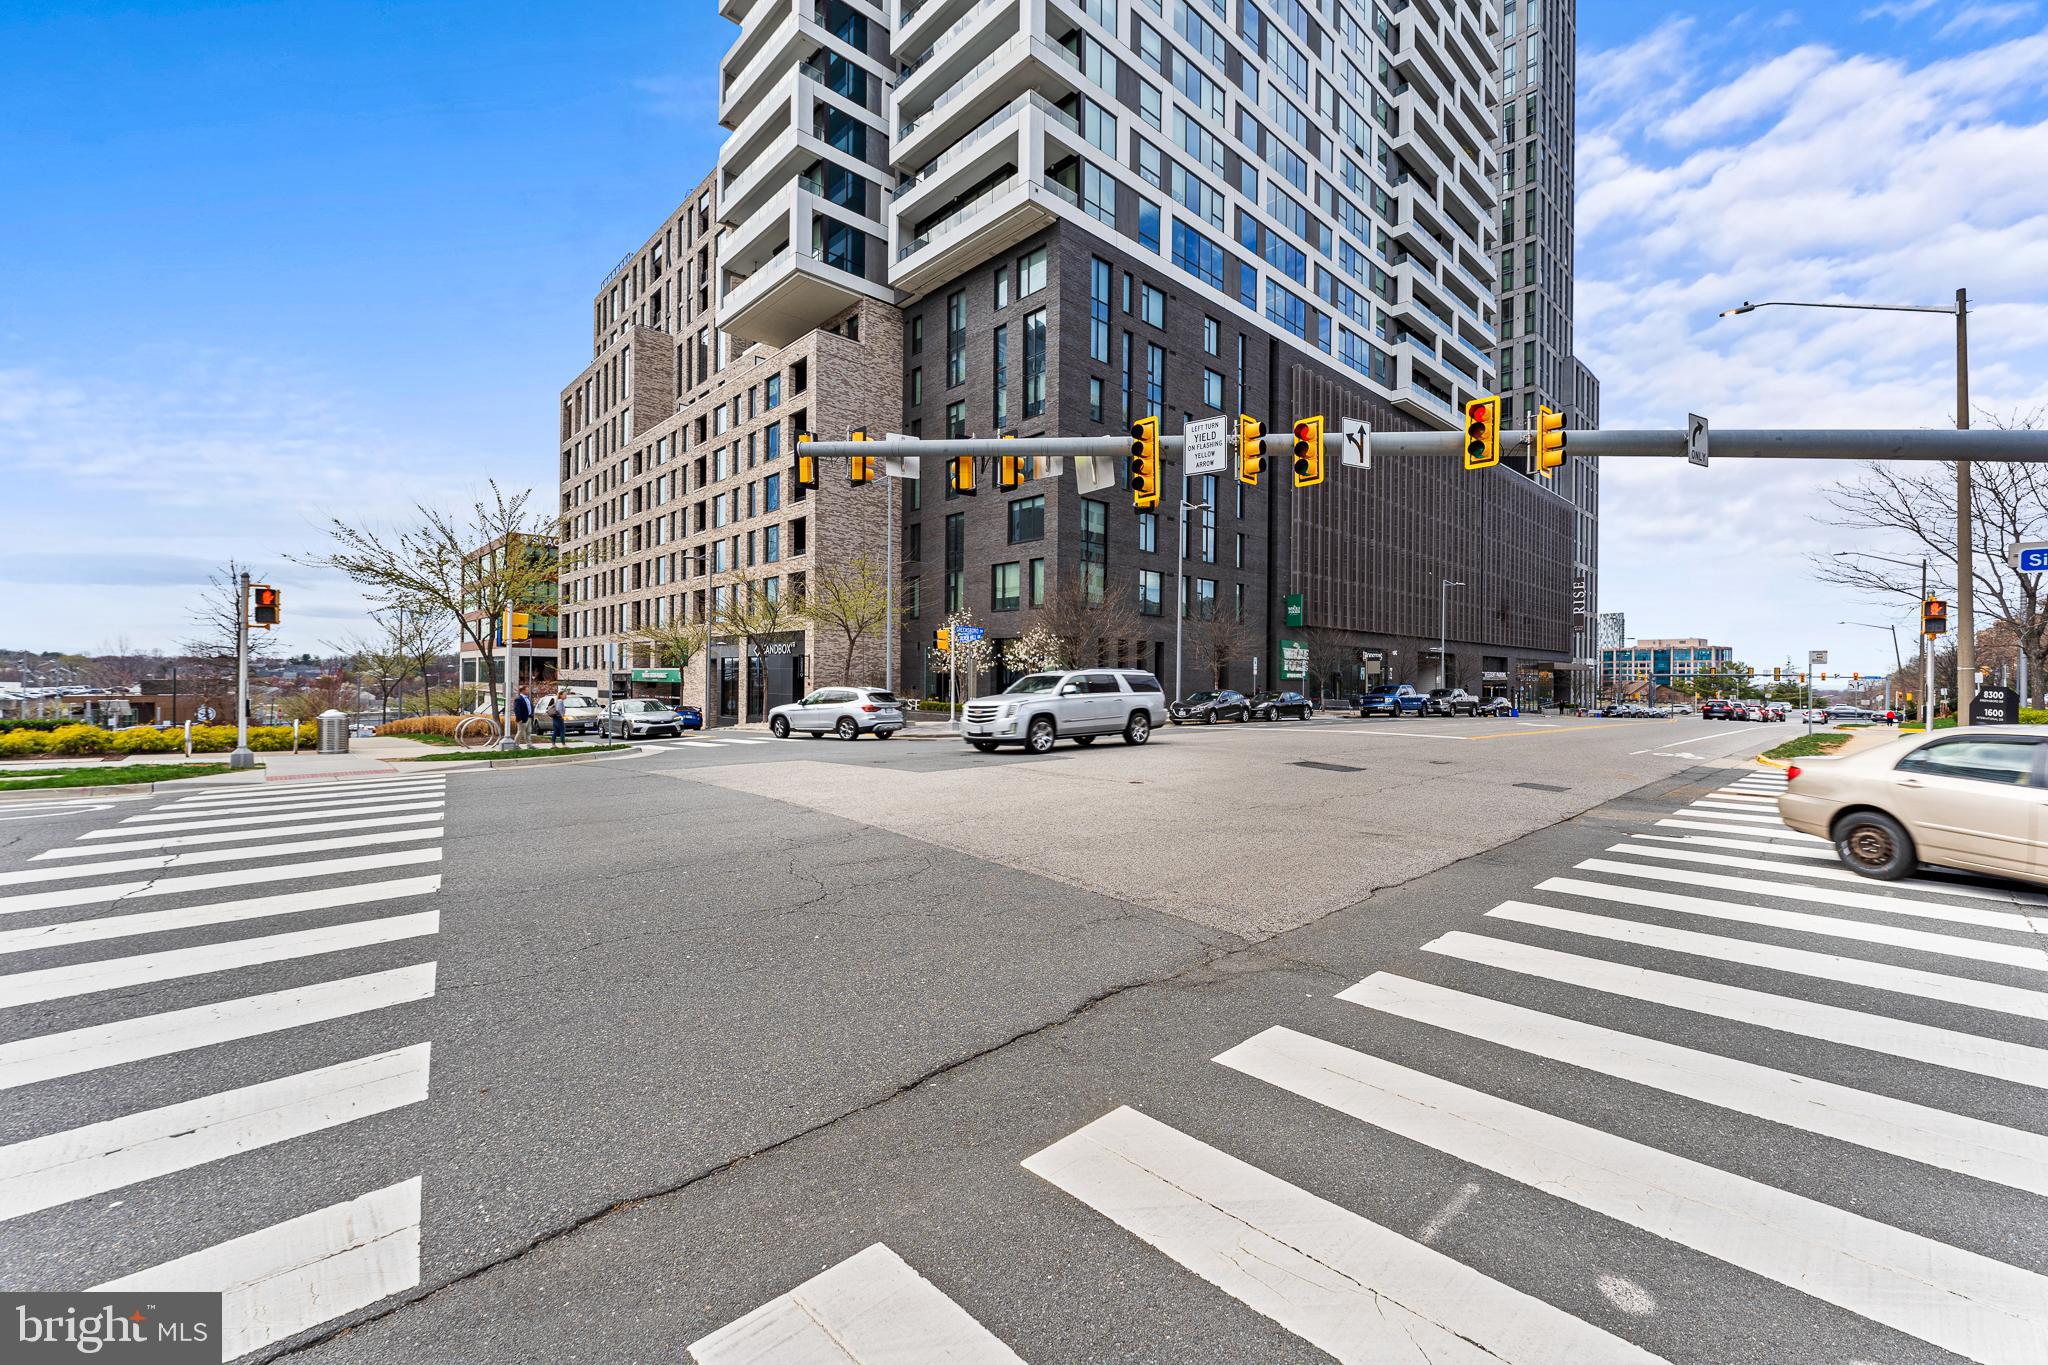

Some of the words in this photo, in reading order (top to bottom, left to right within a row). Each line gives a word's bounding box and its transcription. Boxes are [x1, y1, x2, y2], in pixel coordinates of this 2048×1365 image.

[1205, 422, 1219, 430] TURN
[1194, 431, 1216, 442] YIELD
[1197, 440, 1222, 449] FLASHING
[1195, 451, 1215, 459] YELLOW
[1692, 450, 1706, 461] ONLY
[1196, 460, 1214, 468] ARROW
[533, 535, 561, 547] SPAC
[2029, 553, 2048, 566] Si
[1573, 582, 1584, 614] RISE
[1983, 690, 2004, 699] 8300
[907, 698, 921, 711] SE
[1984, 709, 2004, 717] 1600
